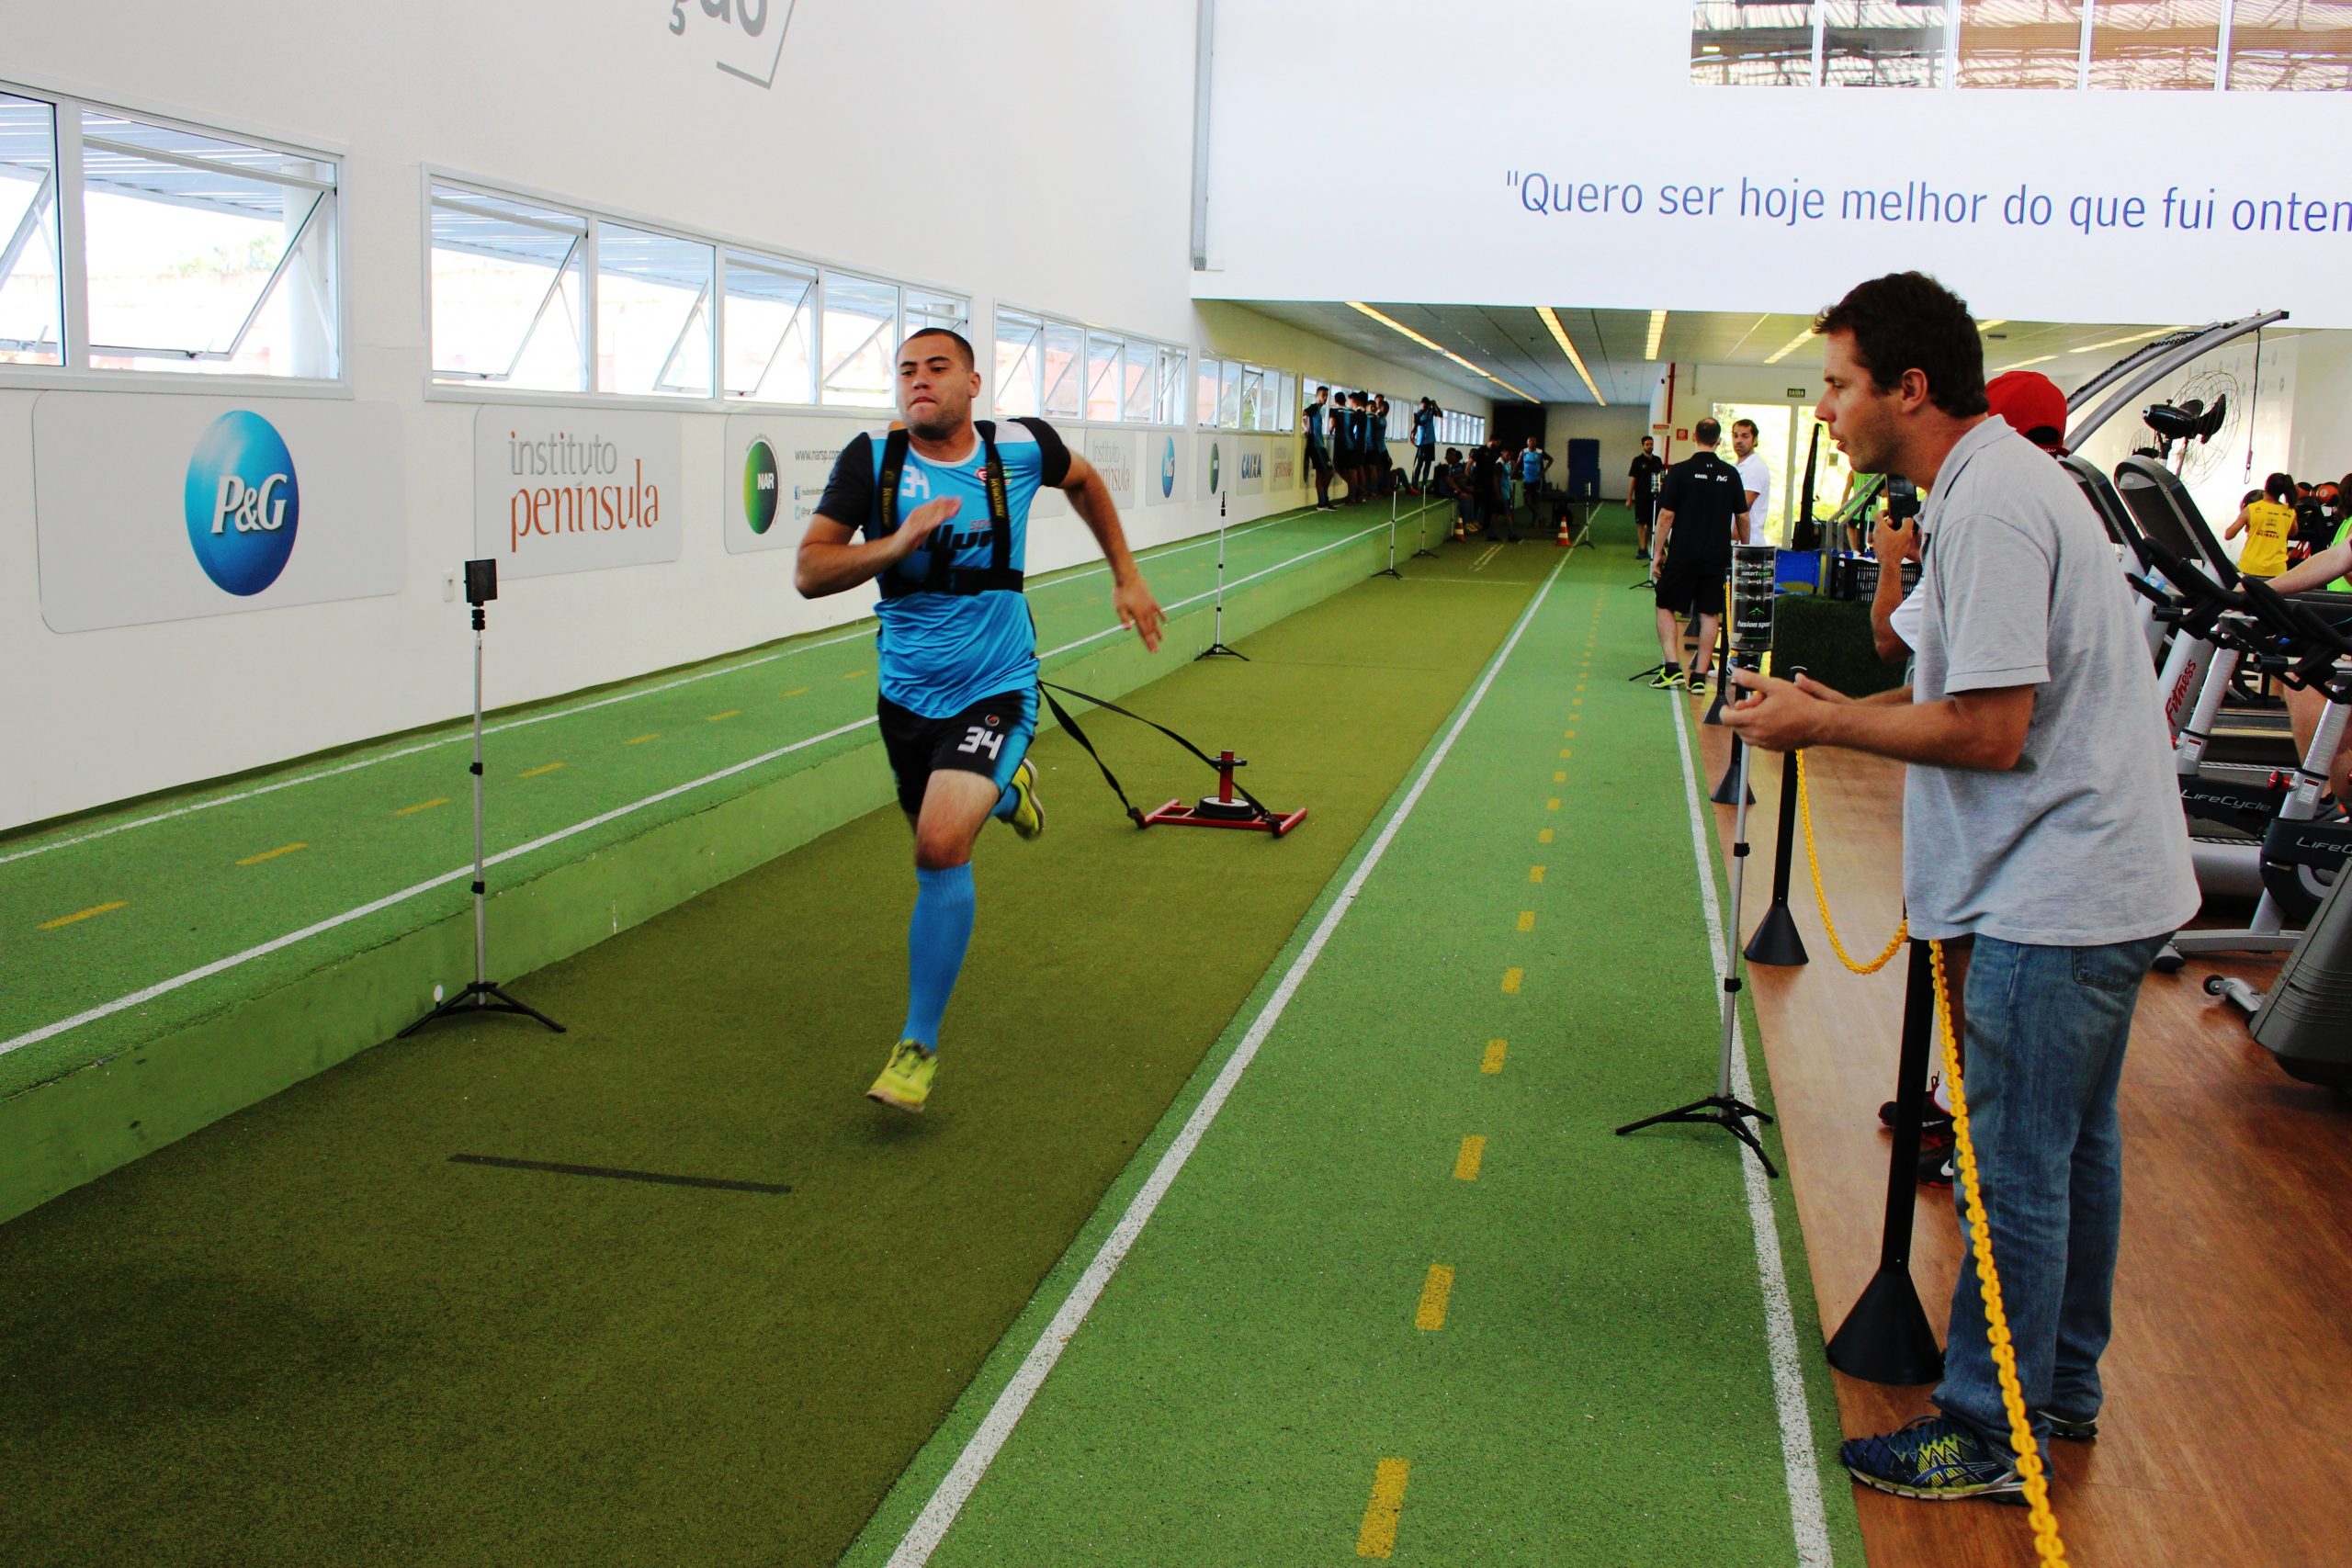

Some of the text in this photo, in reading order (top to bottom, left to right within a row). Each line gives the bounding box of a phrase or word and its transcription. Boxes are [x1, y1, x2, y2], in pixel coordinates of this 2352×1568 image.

[1507, 170, 1643, 216] "Quero
[1658, 184, 1724, 215] ser
[1740, 176, 1824, 226] hoje
[1842, 181, 1987, 223] melhor
[2003, 184, 2052, 225] do
[2069, 195, 2145, 235] que
[2162, 186, 2215, 229] fui
[509, 431, 617, 475] instituto
[1241, 453, 1261, 479] CAIXA
[757, 472, 775, 491] NAR
[901, 464, 930, 500] 34
[210, 473, 288, 534] P&G
[511, 458, 659, 553] península
[1737, 620, 1758, 628] fusion
[2165, 659, 2197, 727] Fitness
[956, 726, 1005, 761] 34
